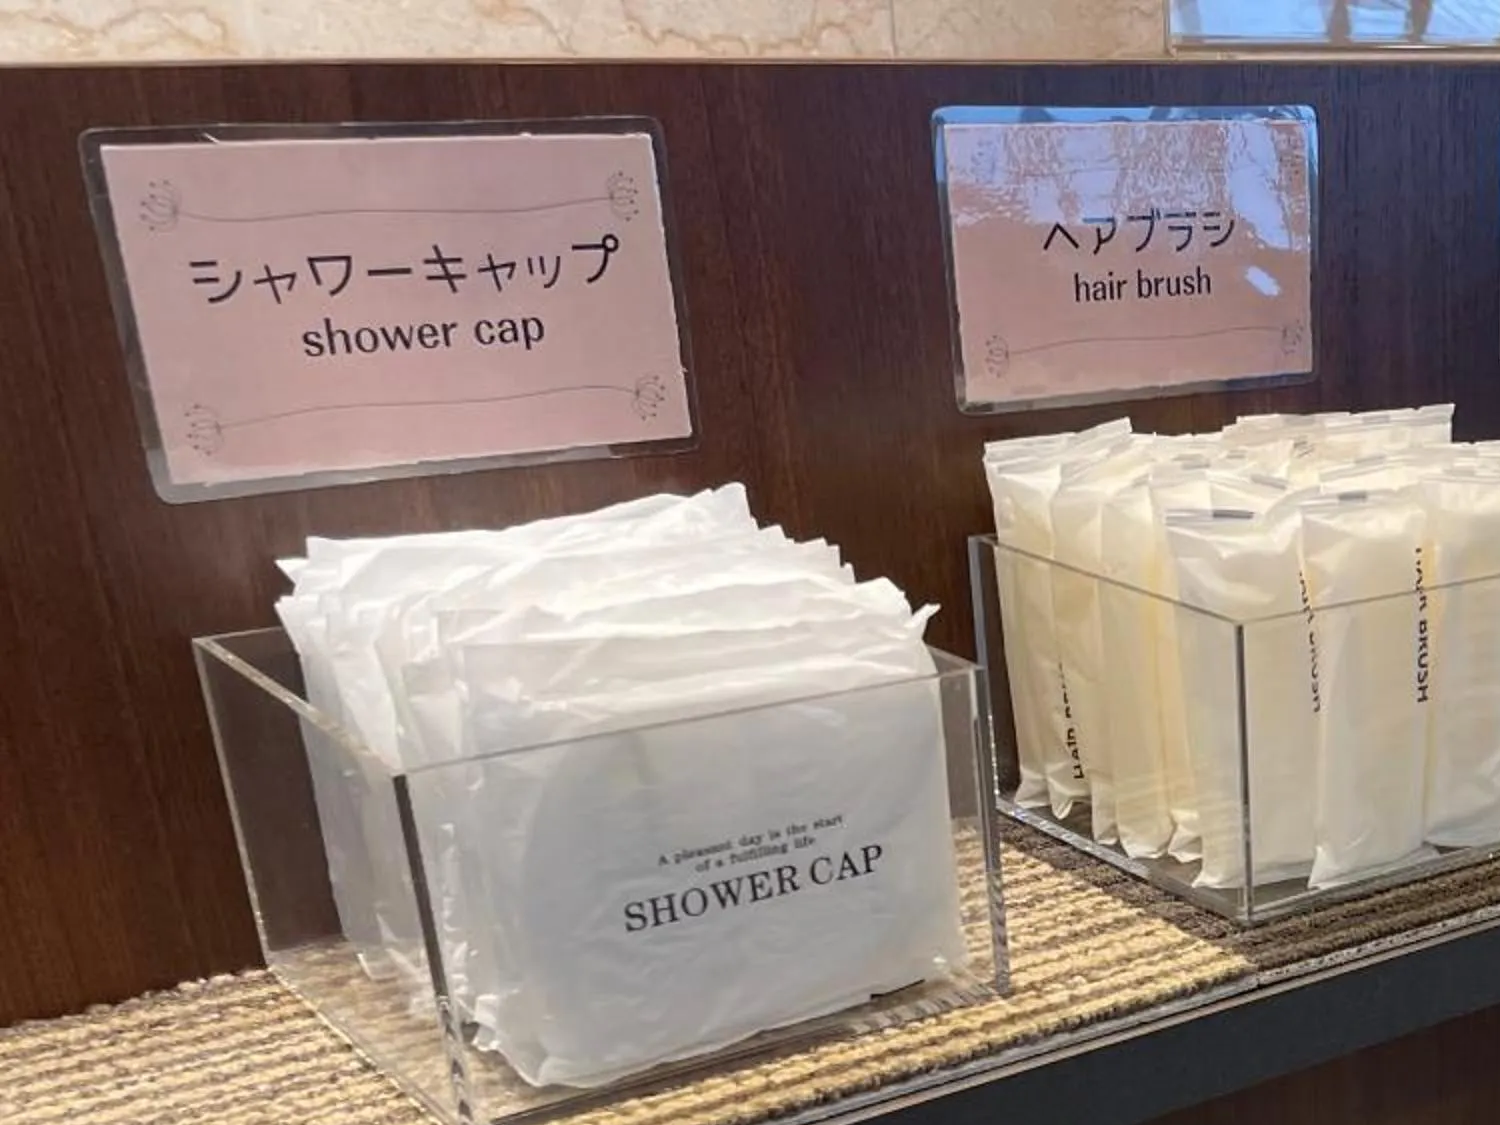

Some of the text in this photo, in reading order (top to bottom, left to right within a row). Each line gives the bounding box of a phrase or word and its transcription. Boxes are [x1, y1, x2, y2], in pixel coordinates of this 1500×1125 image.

[1043, 207, 1236, 254] ヘアブラシ
[190, 234, 619, 303] シャワーキャップ
[1074, 266, 1211, 303] hair brush
[302, 314, 545, 358] shower cap
[739, 834, 765, 847] day
[786, 823, 807, 836] the
[813, 815, 843, 829] start
[695, 858, 711, 872] of
[715, 859, 725, 868] a
[624, 845, 883, 932] SHOWER CAP
